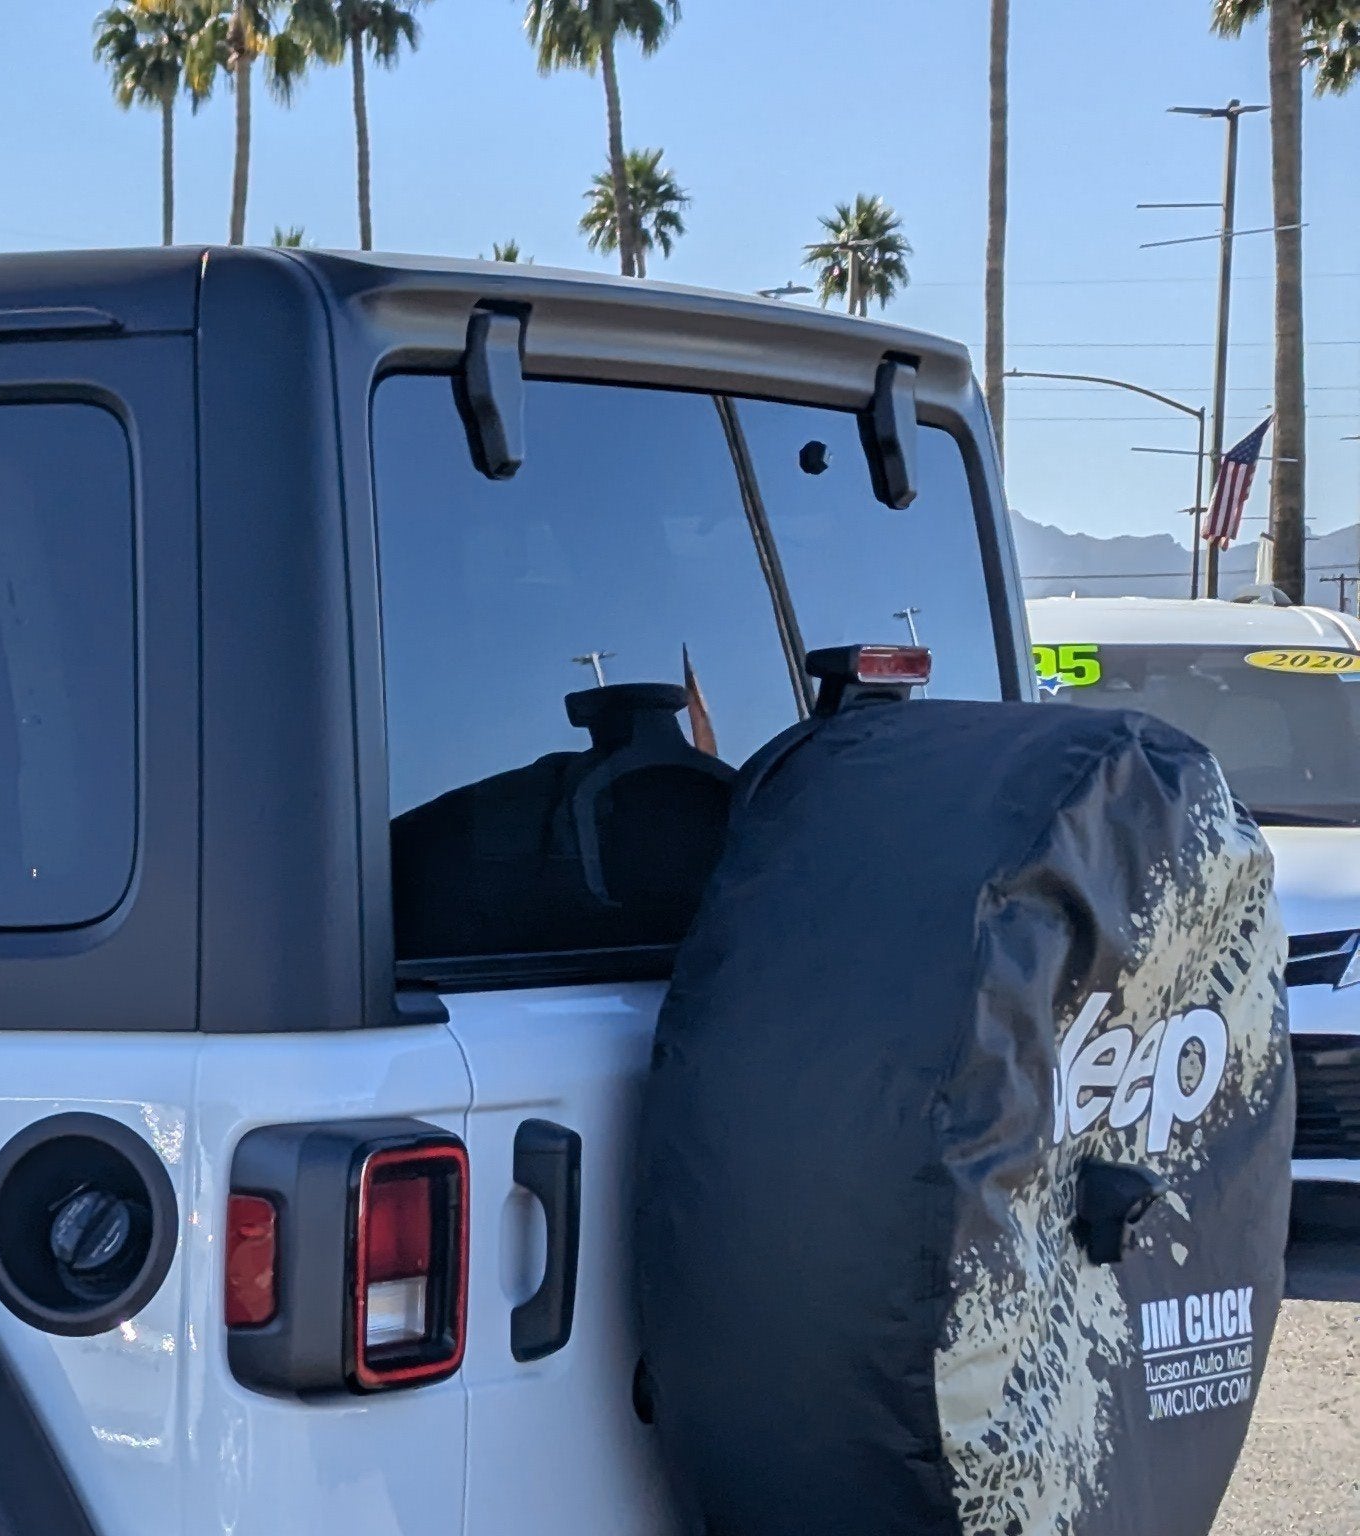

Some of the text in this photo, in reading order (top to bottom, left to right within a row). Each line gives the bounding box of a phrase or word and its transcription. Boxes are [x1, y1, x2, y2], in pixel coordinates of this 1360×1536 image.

[1266, 653, 1355, 670] 2020
[1053, 991, 1228, 1153] Jeep
[1140, 1286, 1254, 1351] JIM CLICK
[1143, 1360, 1191, 1384] Tucson
[1193, 1351, 1225, 1376] Auto
[1148, 1374, 1253, 1421] JIMCLICK.COM
